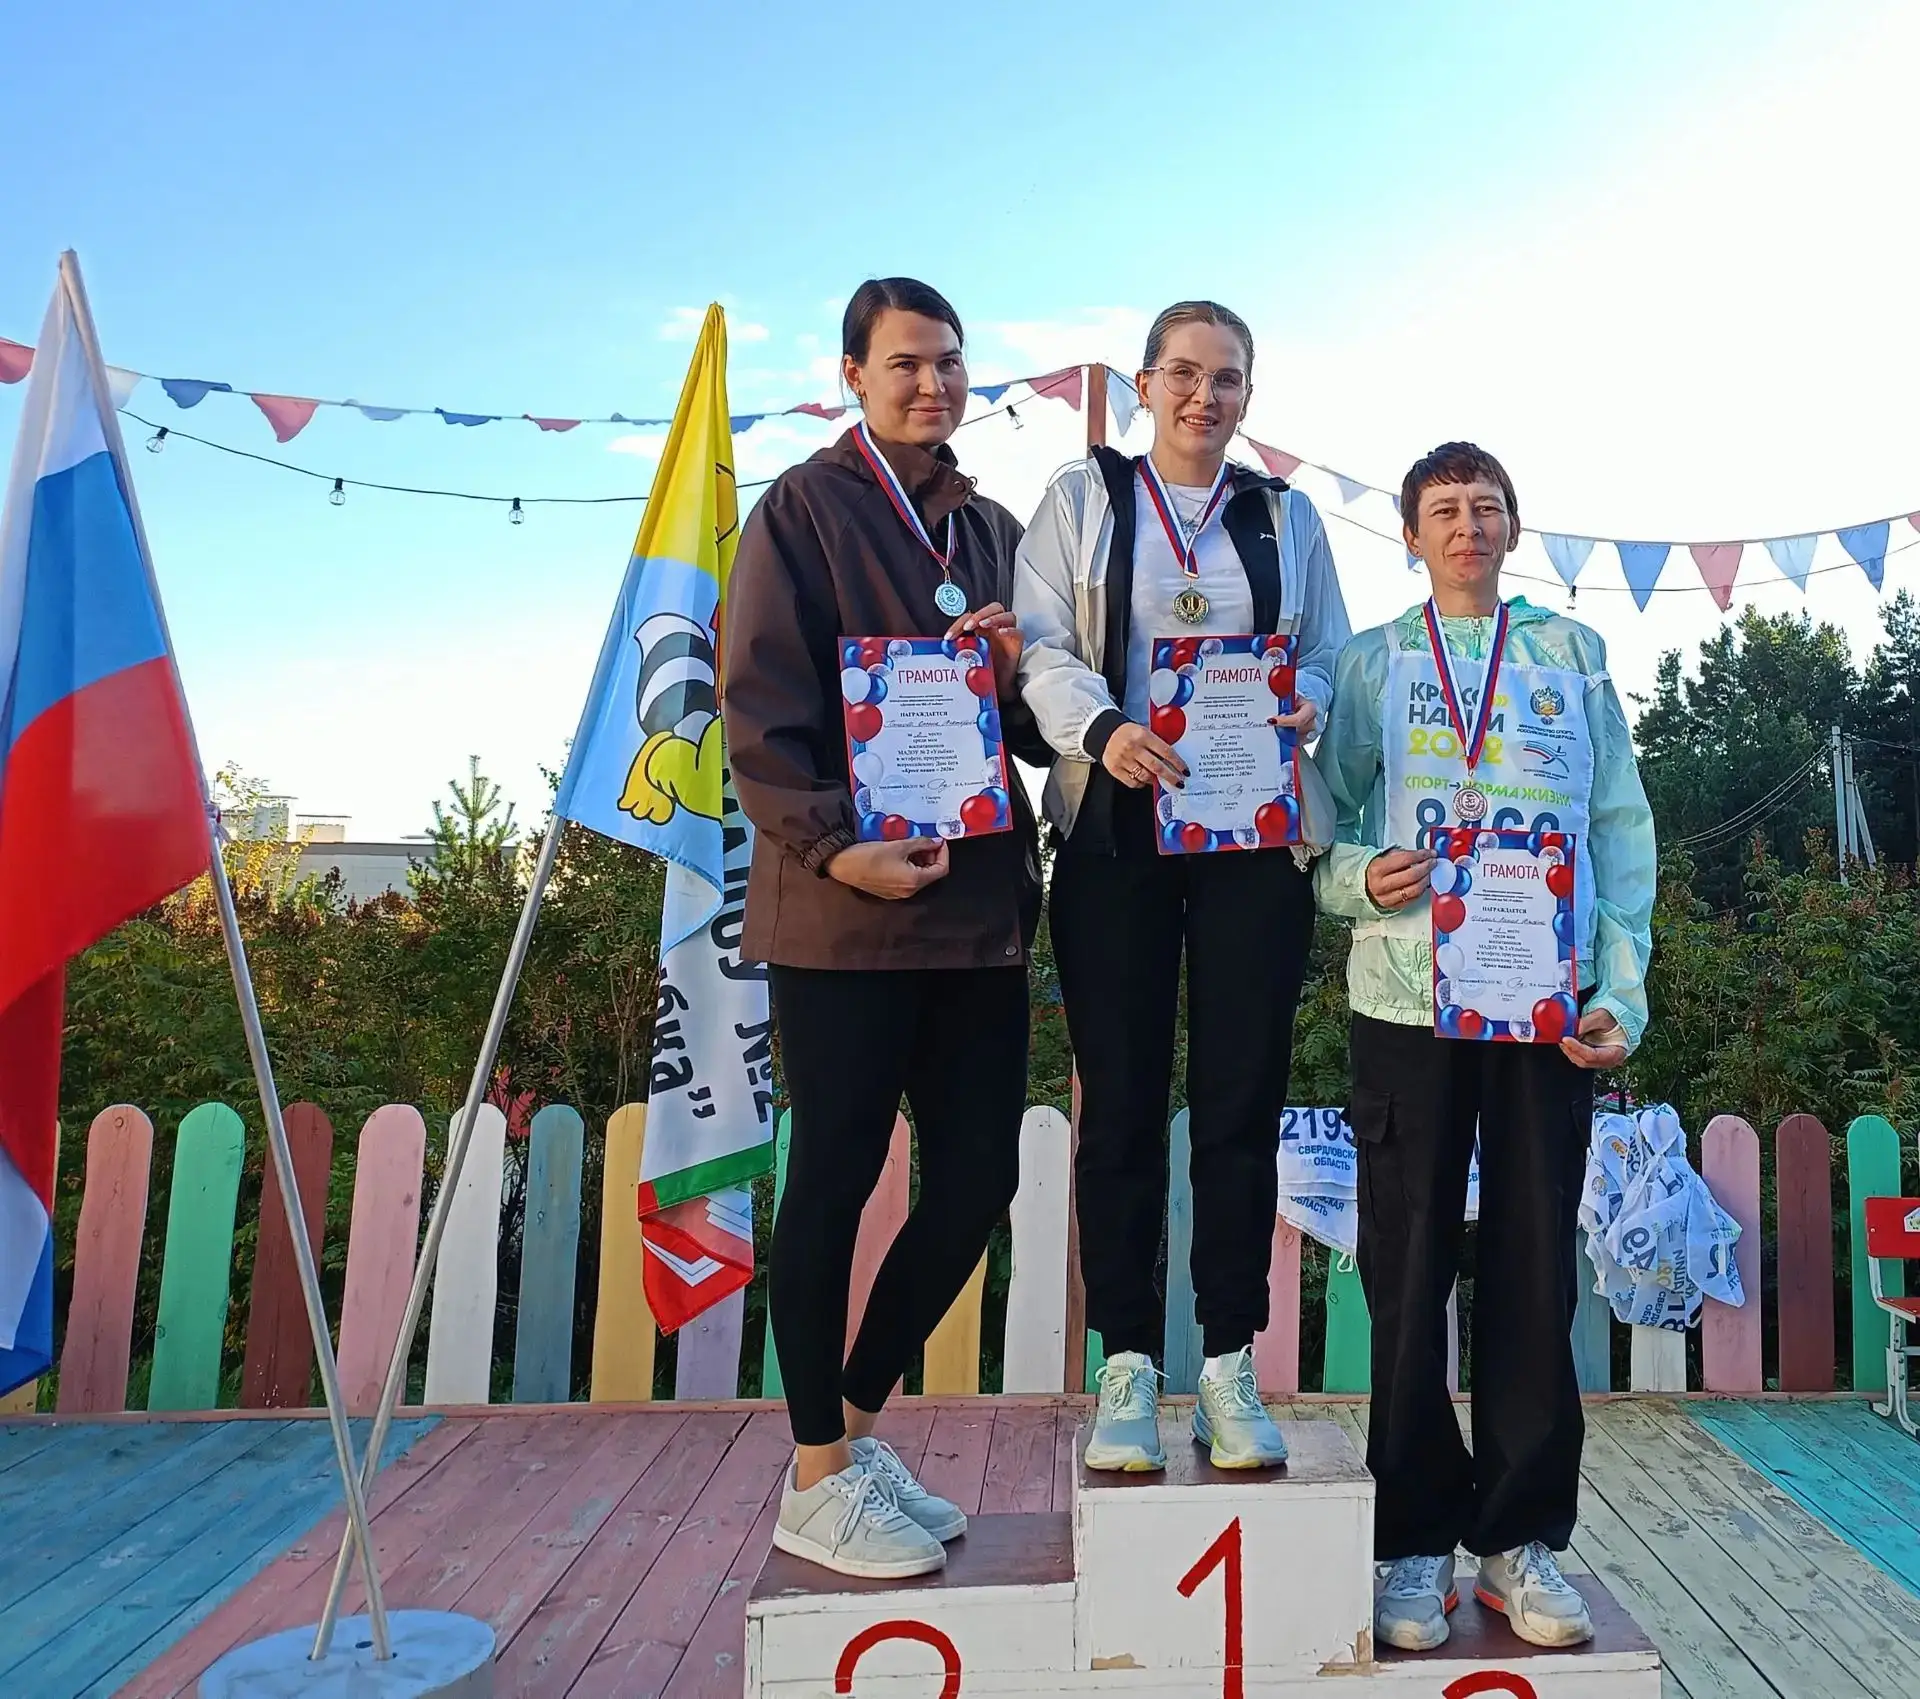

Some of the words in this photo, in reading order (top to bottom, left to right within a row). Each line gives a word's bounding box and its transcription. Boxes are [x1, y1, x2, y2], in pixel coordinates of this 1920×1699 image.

[898, 669, 959, 684] ГРАМОТА
[1205, 668, 1262, 684] ГРАМОТА
[1203, 712, 1249, 720] НАГРАЖДАЕТСЯ
[1408, 728, 1503, 764] 202
[1404, 775, 1450, 791] СПОРТ
[1521, 786, 1572, 808] ЖИЗНИ
[1483, 863, 1540, 880] ГРАМОТА
[1482, 906, 1527, 914] НАГРАЖДАЕТСЯ
[1314, 1156, 1351, 1171] ОБЛАСТЬ
[1176, 1516, 1243, 1699] 1
